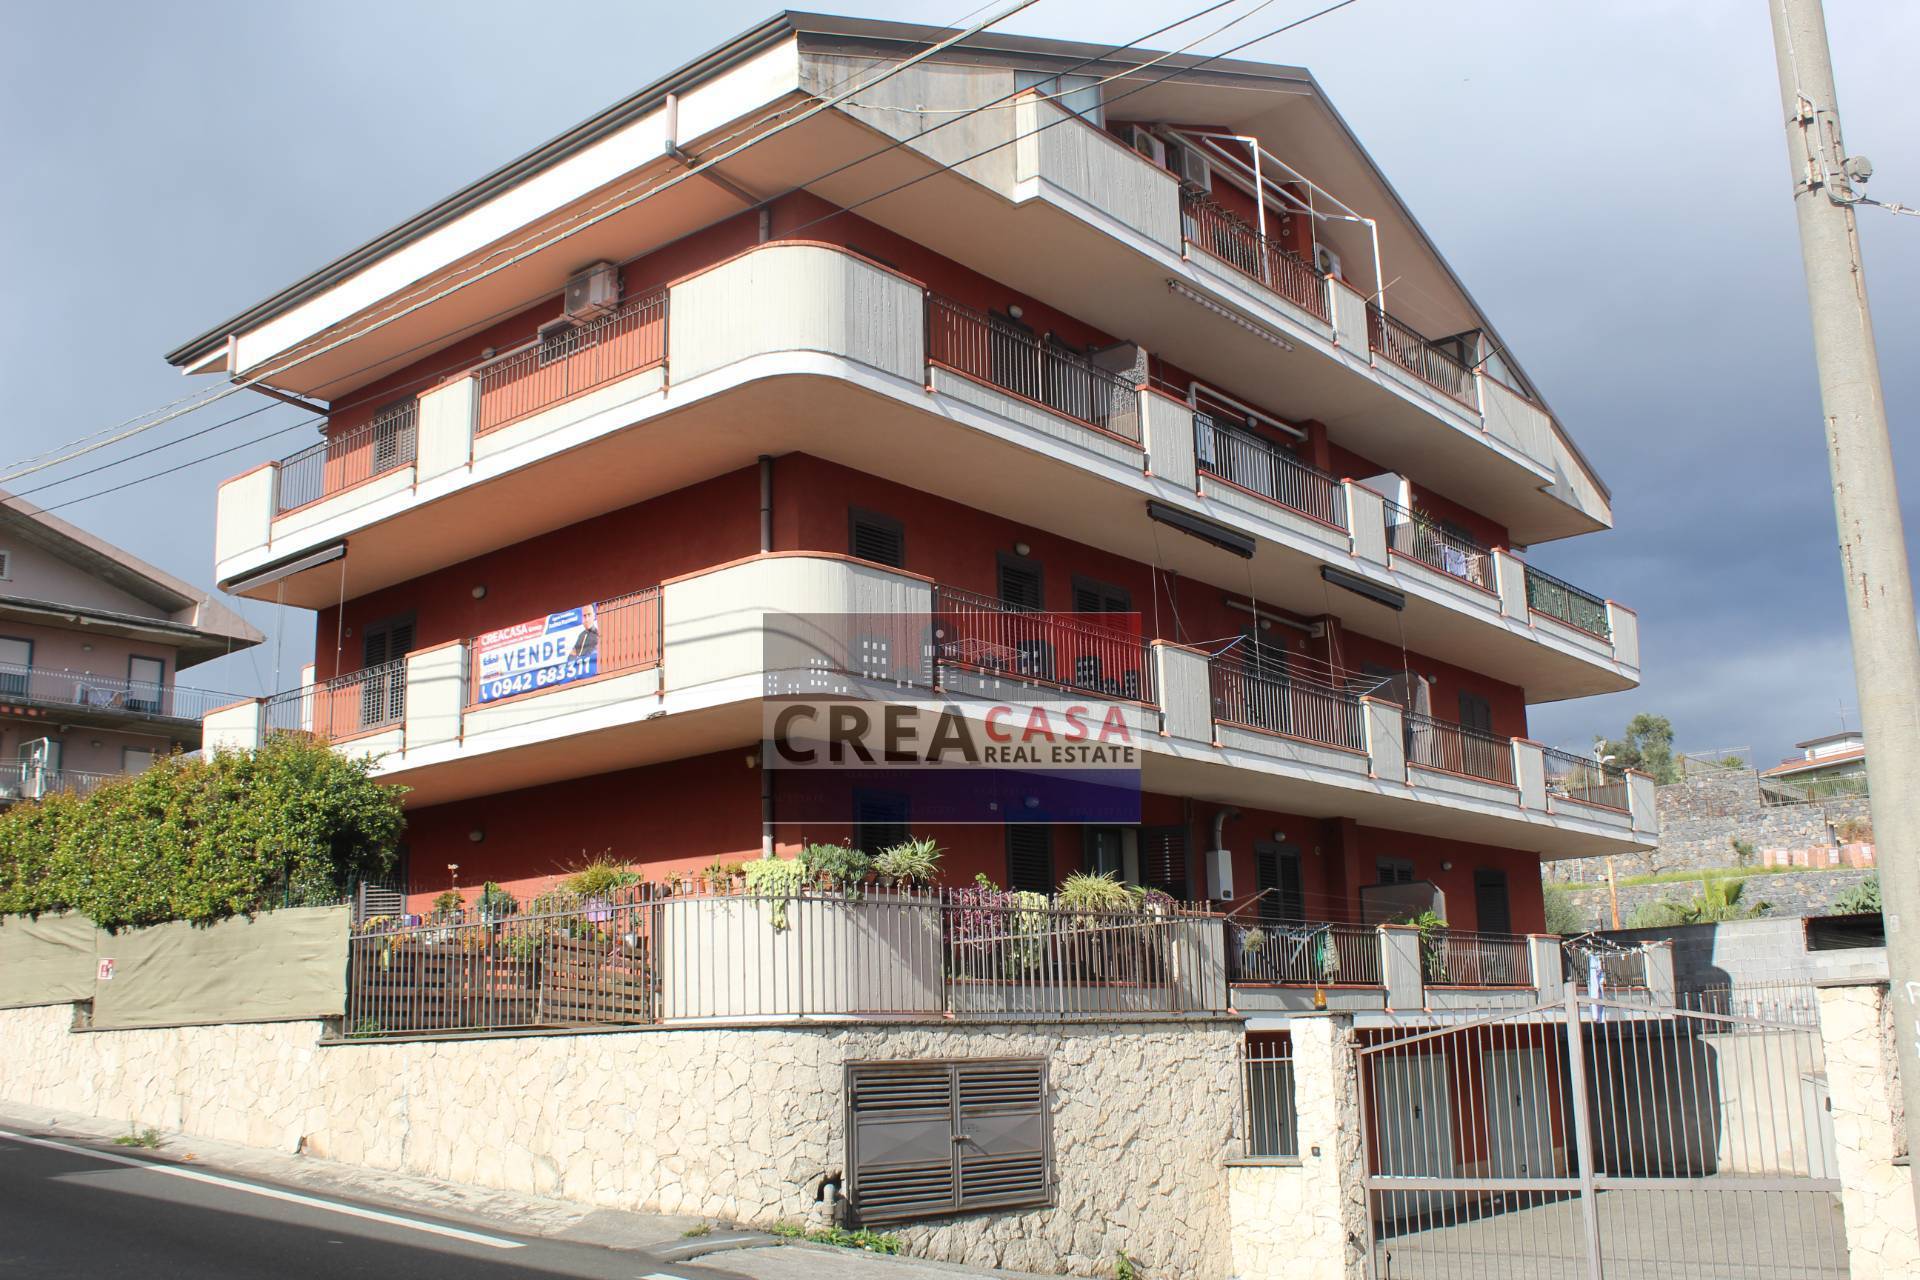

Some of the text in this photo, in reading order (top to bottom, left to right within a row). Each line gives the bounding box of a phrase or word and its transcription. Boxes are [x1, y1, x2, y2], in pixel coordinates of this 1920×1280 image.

[481, 624, 529, 646] CREACASA
[503, 637, 566, 671] VENDE
[491, 656, 591, 698] 0942 683311
